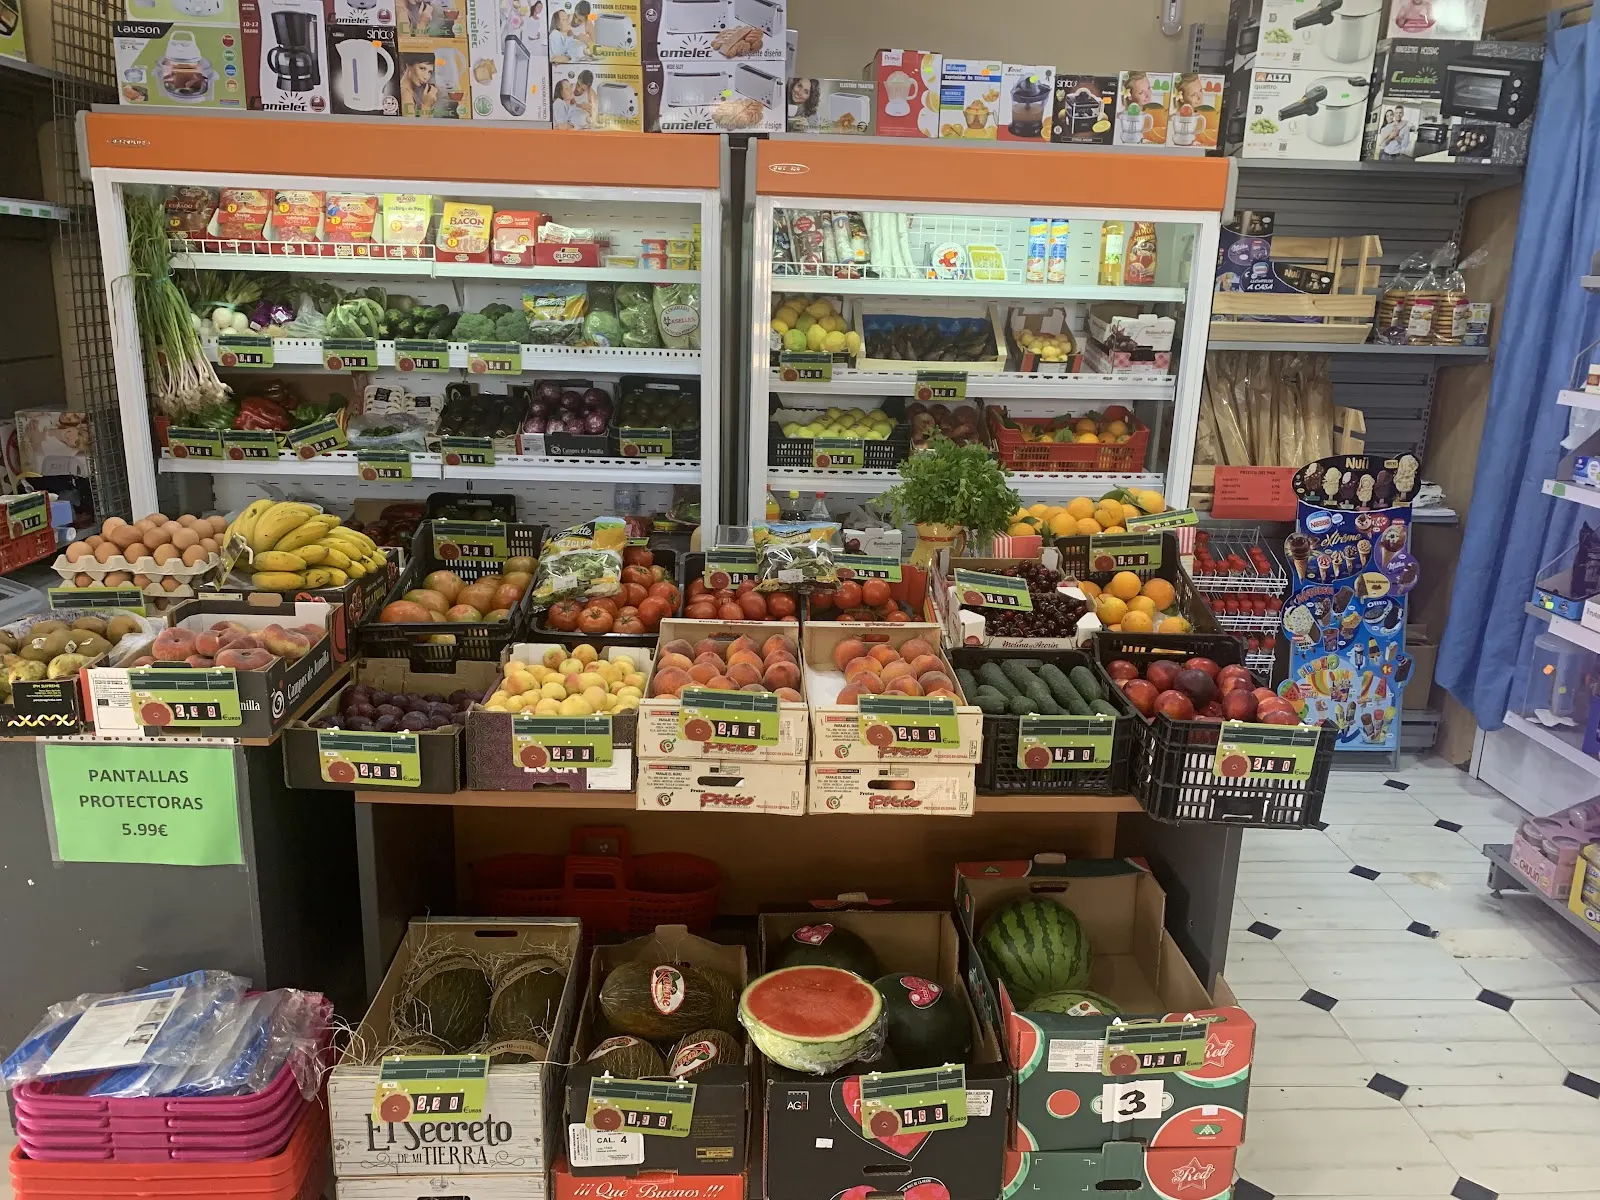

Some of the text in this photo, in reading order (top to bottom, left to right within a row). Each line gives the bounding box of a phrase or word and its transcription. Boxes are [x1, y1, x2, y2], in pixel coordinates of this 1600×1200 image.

[1391, 69, 1439, 85] Comelec
[449, 216, 485, 226] BACON
[555, 252, 581, 260] ELPOZO
[1255, 283, 1275, 291] CASA
[1366, 600, 1388, 609] OREO
[287, 649, 330, 701] Campos de Jumilla
[88, 769, 189, 784] PANTALLAS
[79, 795, 204, 811] PROTECTORAS
[121, 823, 169, 837] 5.99€
[1117, 1089, 1147, 1117] 3
[903, 1107, 943, 1126] 1,69
[404, 1112, 513, 1151] Secreto
[620, 1135, 628, 1144] 4
[397, 1145, 489, 1166] DE MI TIERRA
[1172, 1162, 1216, 1184] Red
[595, 1181, 630, 1198] Qué
[635, 1184, 701, 1199] Buenos
